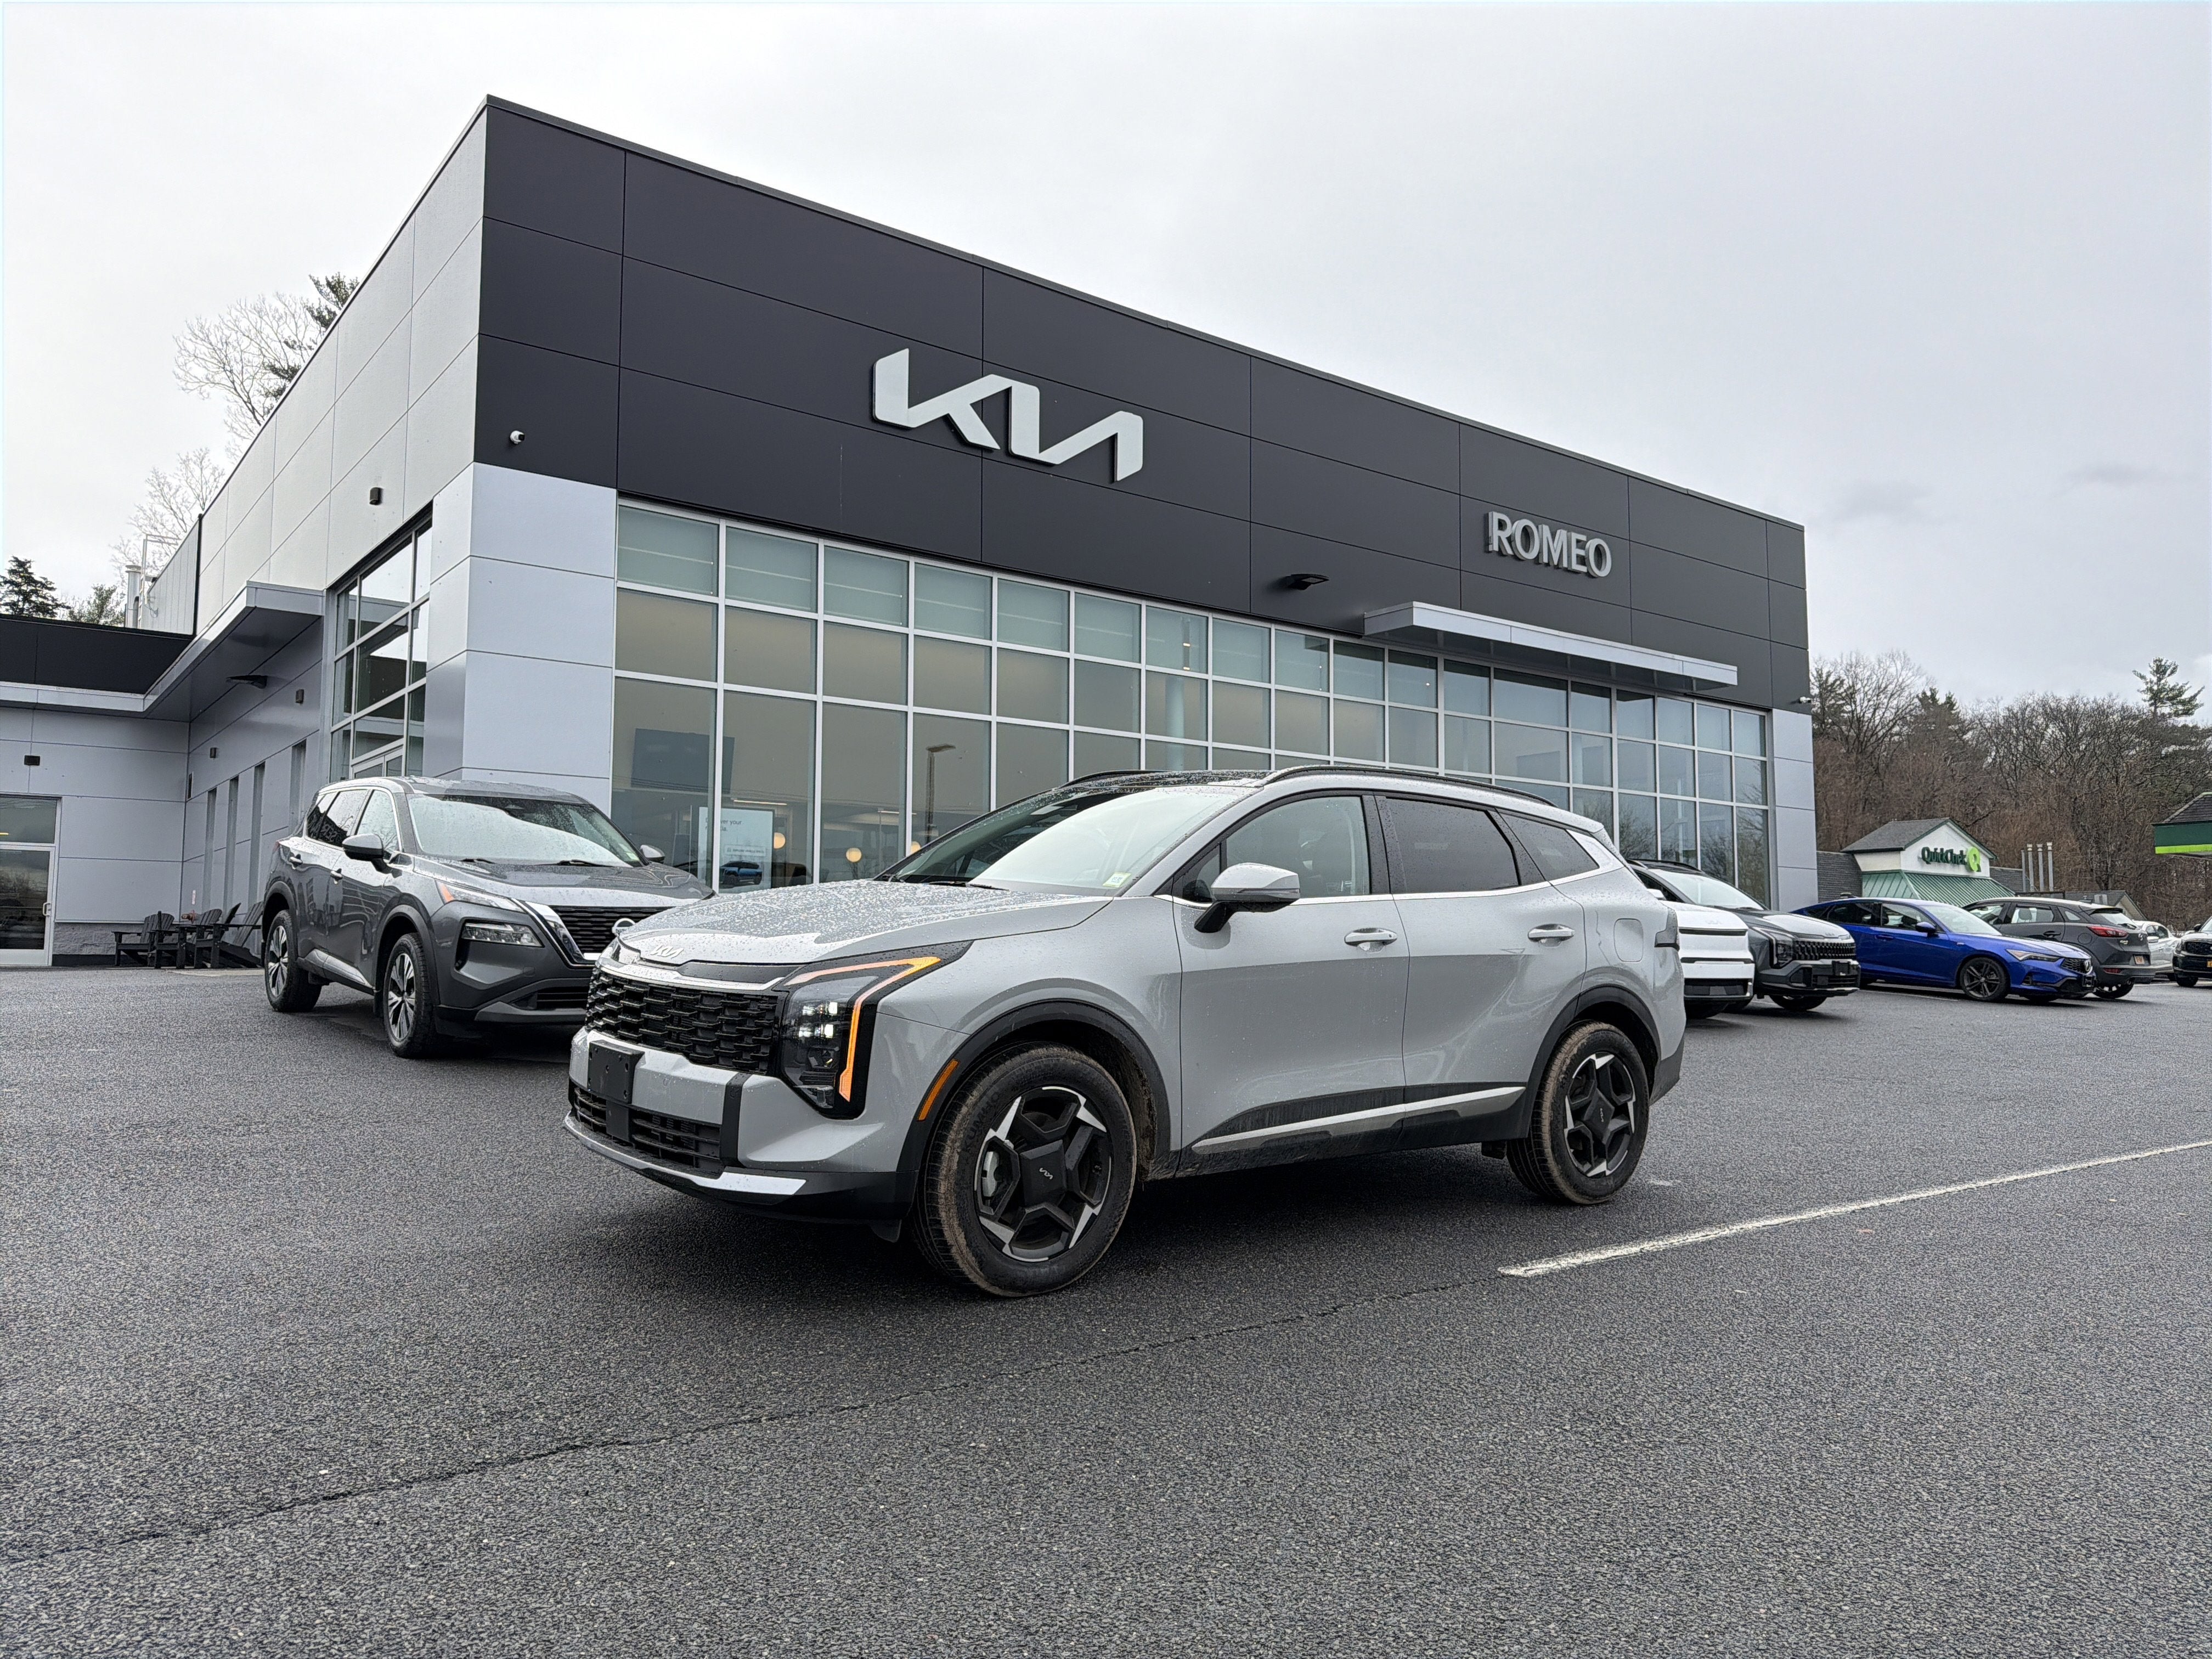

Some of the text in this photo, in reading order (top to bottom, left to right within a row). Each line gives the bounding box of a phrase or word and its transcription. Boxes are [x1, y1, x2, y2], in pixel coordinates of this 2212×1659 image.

[873, 348, 1143, 481] KIA
[1488, 511, 1612, 578] ROMEO
[650, 943, 684, 960] KIA
[1039, 1167, 1053, 1180] KIA
